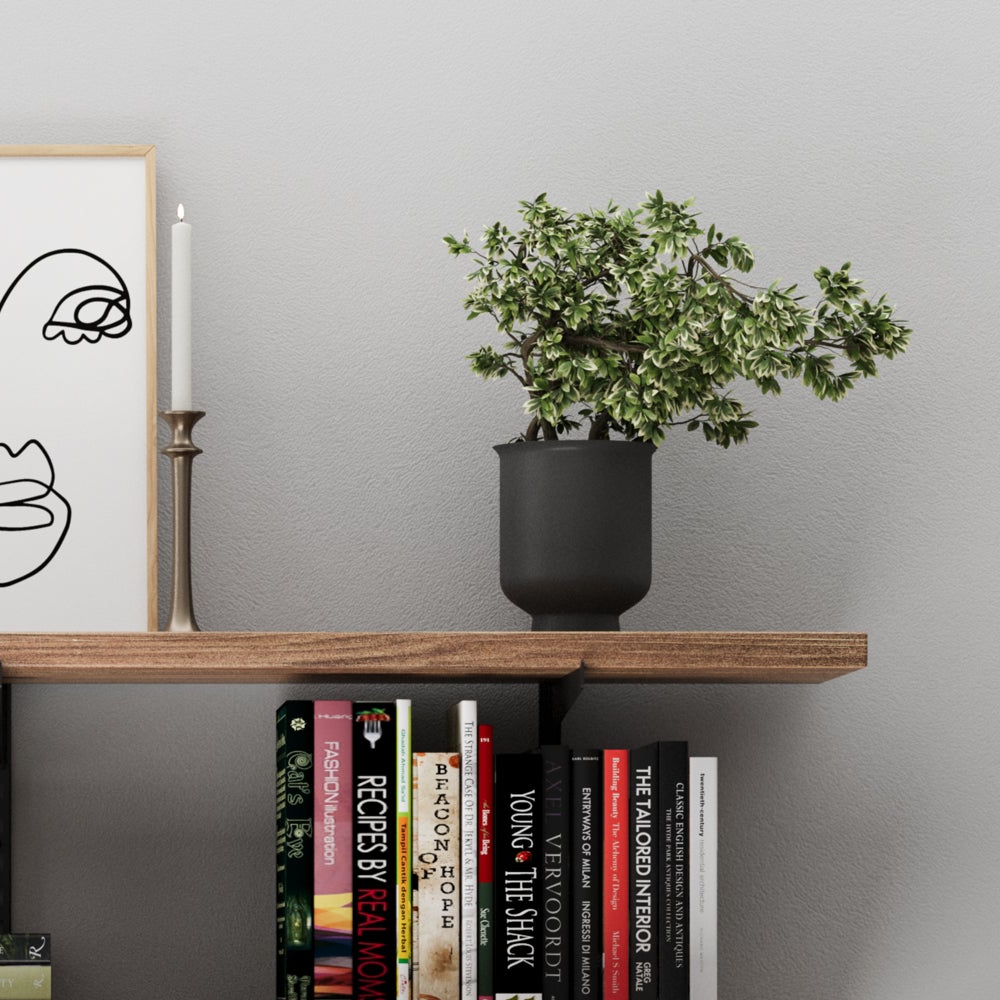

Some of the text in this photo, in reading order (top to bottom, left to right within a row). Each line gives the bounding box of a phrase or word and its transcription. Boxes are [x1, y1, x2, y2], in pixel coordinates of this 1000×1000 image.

[610, 757, 621, 791] Building
[324, 741, 340, 865] FASHION illustration
[357, 775, 388, 853] RECIPES
[434, 763, 451, 851] BEACON
[610, 792, 621, 819] Beauty
[399, 823, 407, 854] Tampil
[611, 822, 621, 839] The
[357, 859, 388, 883] BY
[418, 852, 438, 880] OF
[545, 759, 562, 983] AXEL VERVOORDT
[610, 840, 621, 872] Alchemy
[635, 765, 652, 953] THE TAILORED INTERIOR
[504, 789, 538, 970] YOUNG THE SHACK
[581, 787, 592, 995] ENTRYWAYS OF MILAN INGRESSI DI MILANO
[611, 873, 621, 883] of
[664, 863, 672, 897] ANTIQUES
[673, 782, 685, 969] CLASSIC ENGLISH DESIGN AND ANTIQUES
[357, 889, 388, 937] REAL
[399, 886, 407, 921] dengan
[441, 866, 456, 929] HOPE
[610, 883, 621, 911] Design
[480, 907, 490, 946] Sue Chenette
[611, 930, 621, 960] Michael
[611, 970, 620, 994] Smith
[635, 961, 643, 992] NATALE
[643, 961, 651, 984] GREG
